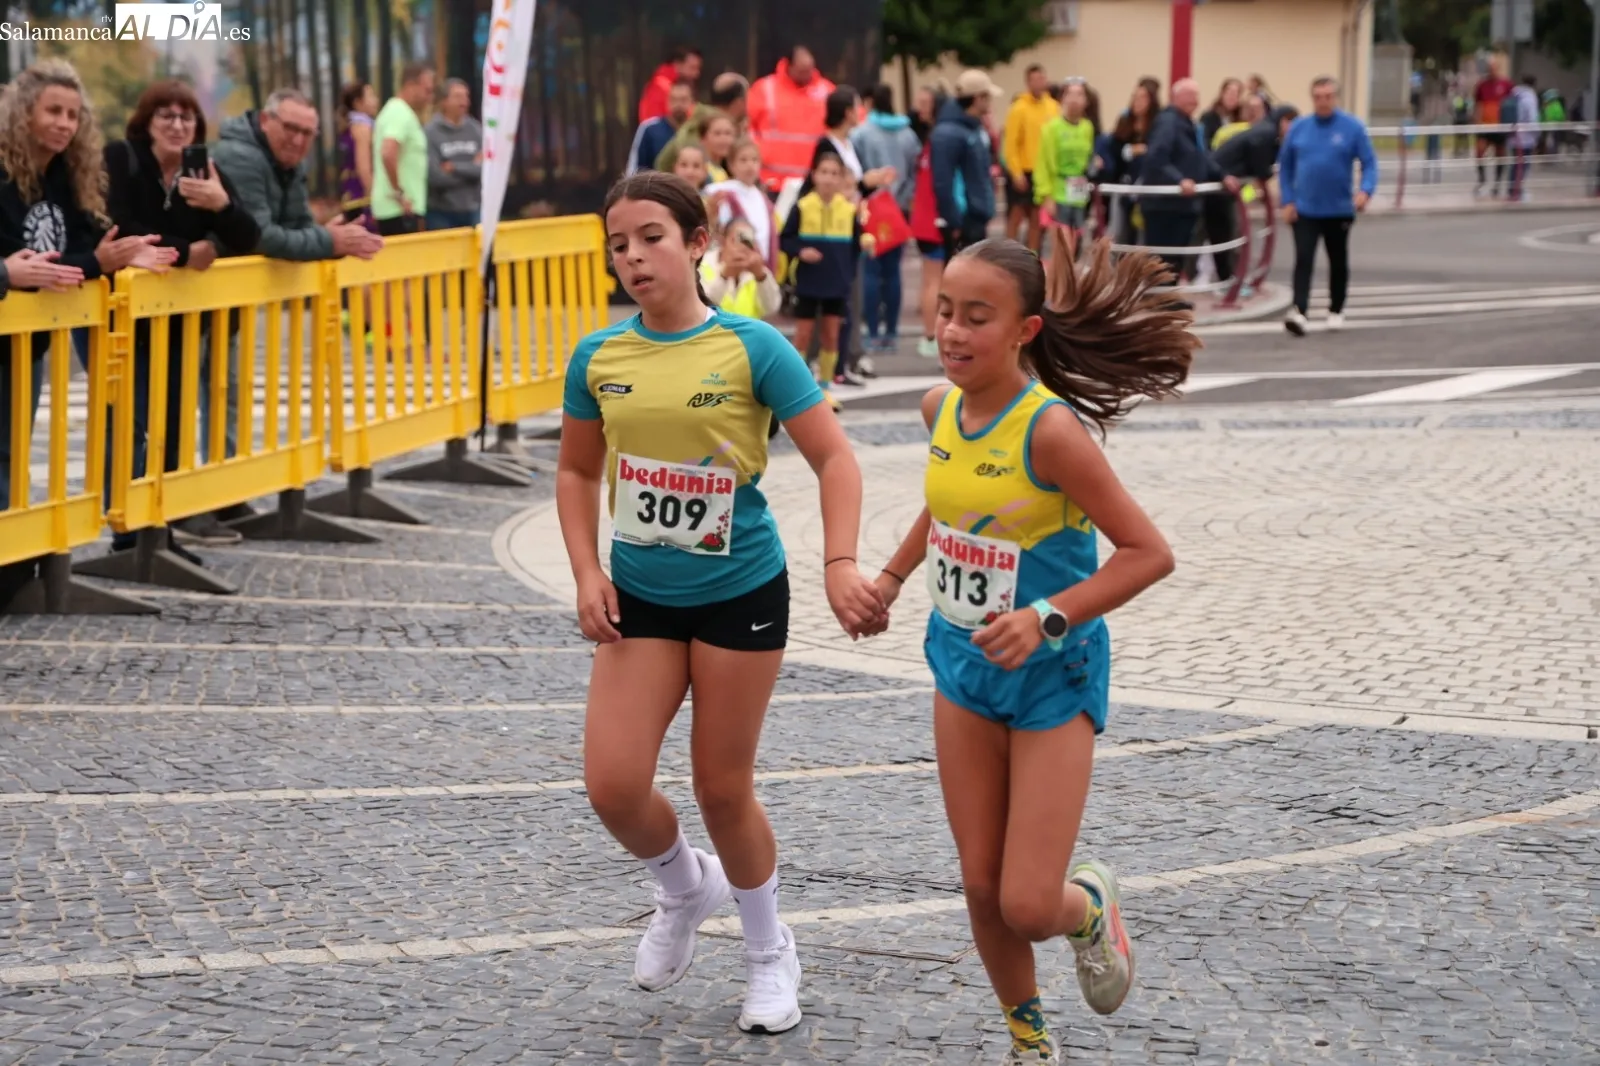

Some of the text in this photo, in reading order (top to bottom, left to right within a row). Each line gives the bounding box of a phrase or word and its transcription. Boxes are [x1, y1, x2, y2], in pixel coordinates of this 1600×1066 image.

[619, 458, 733, 495] bedunia
[636, 490, 708, 532] 309
[936, 557, 989, 607] 313
